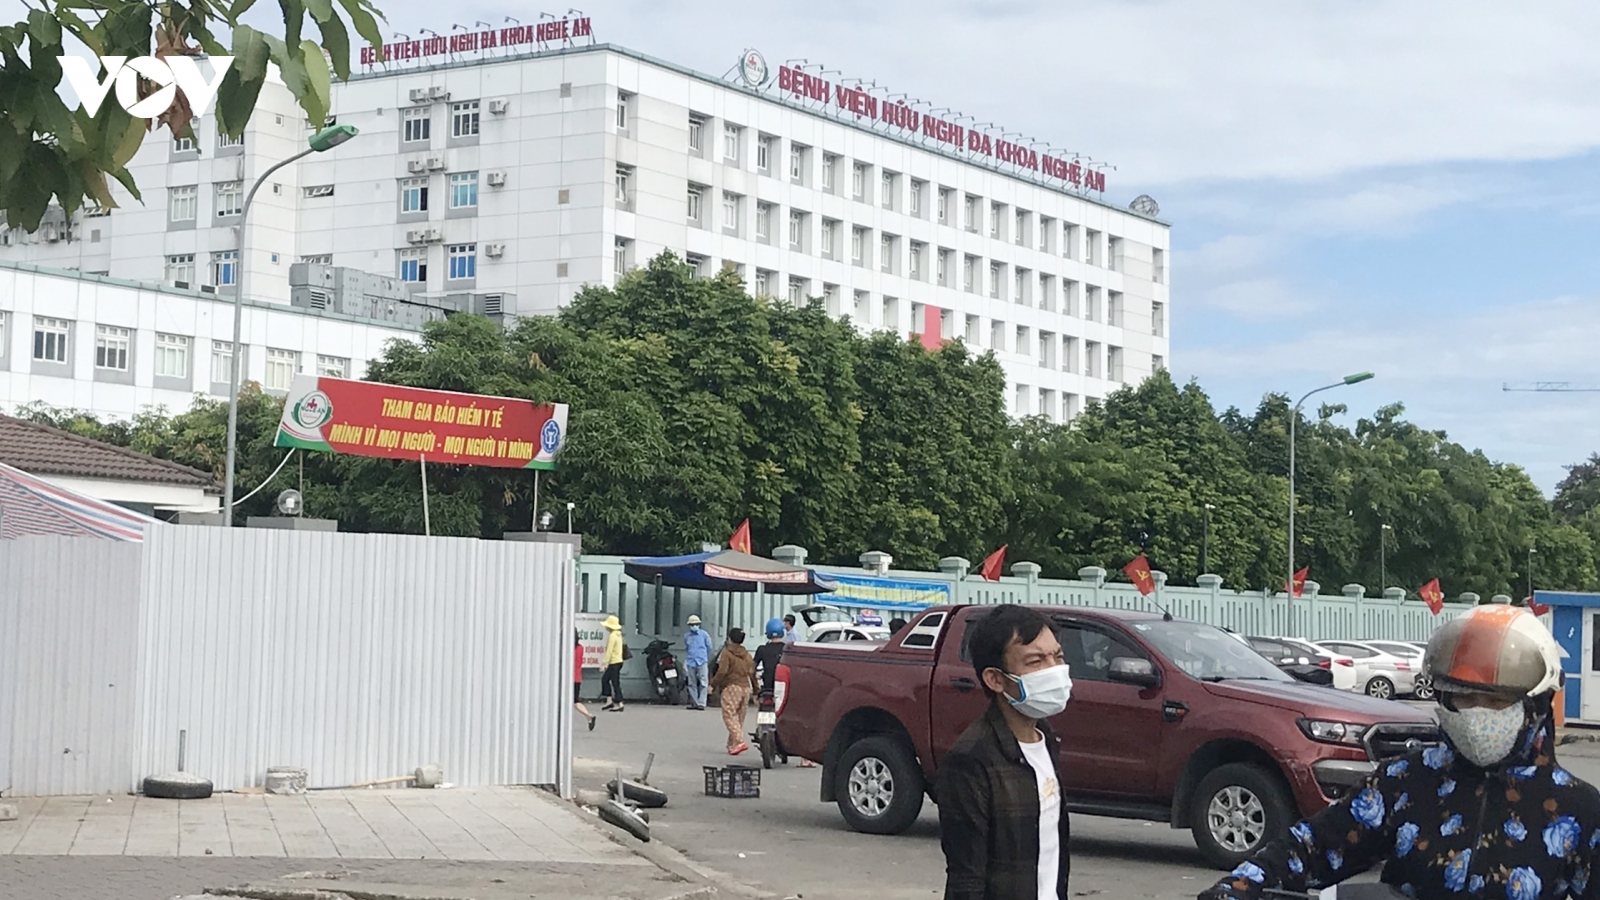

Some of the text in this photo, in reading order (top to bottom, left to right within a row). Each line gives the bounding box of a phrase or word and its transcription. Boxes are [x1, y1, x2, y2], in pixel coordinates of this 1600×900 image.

[361, 42, 391, 67] BỆH
[394, 38, 420, 62] VIỆN
[450, 32, 478, 54] NGHỊ
[481, 30, 497, 49] ĐA
[500, 25, 534, 47] KHOA
[537, 15, 569, 43] NGHỆ
[572, 17, 590, 37] AN
[779, 64, 1105, 192] BỆNH VIỆN HỮU NGHỊ ĐA KHOA NGHỆ AN
[381, 398, 505, 428] THAM GIA BẢO HIỂM Y TẾ
[329, 421, 363, 445] MÌNH
[364, 424, 377, 446] VÌ
[376, 429, 401, 452] MỌI
[401, 429, 436, 452] NGƯỜI
[443, 436, 465, 458] MỌI
[465, 435, 496, 457] NGƯỜI
[497, 437, 507, 458] VÌ
[508, 438, 533, 460] MÌNH
